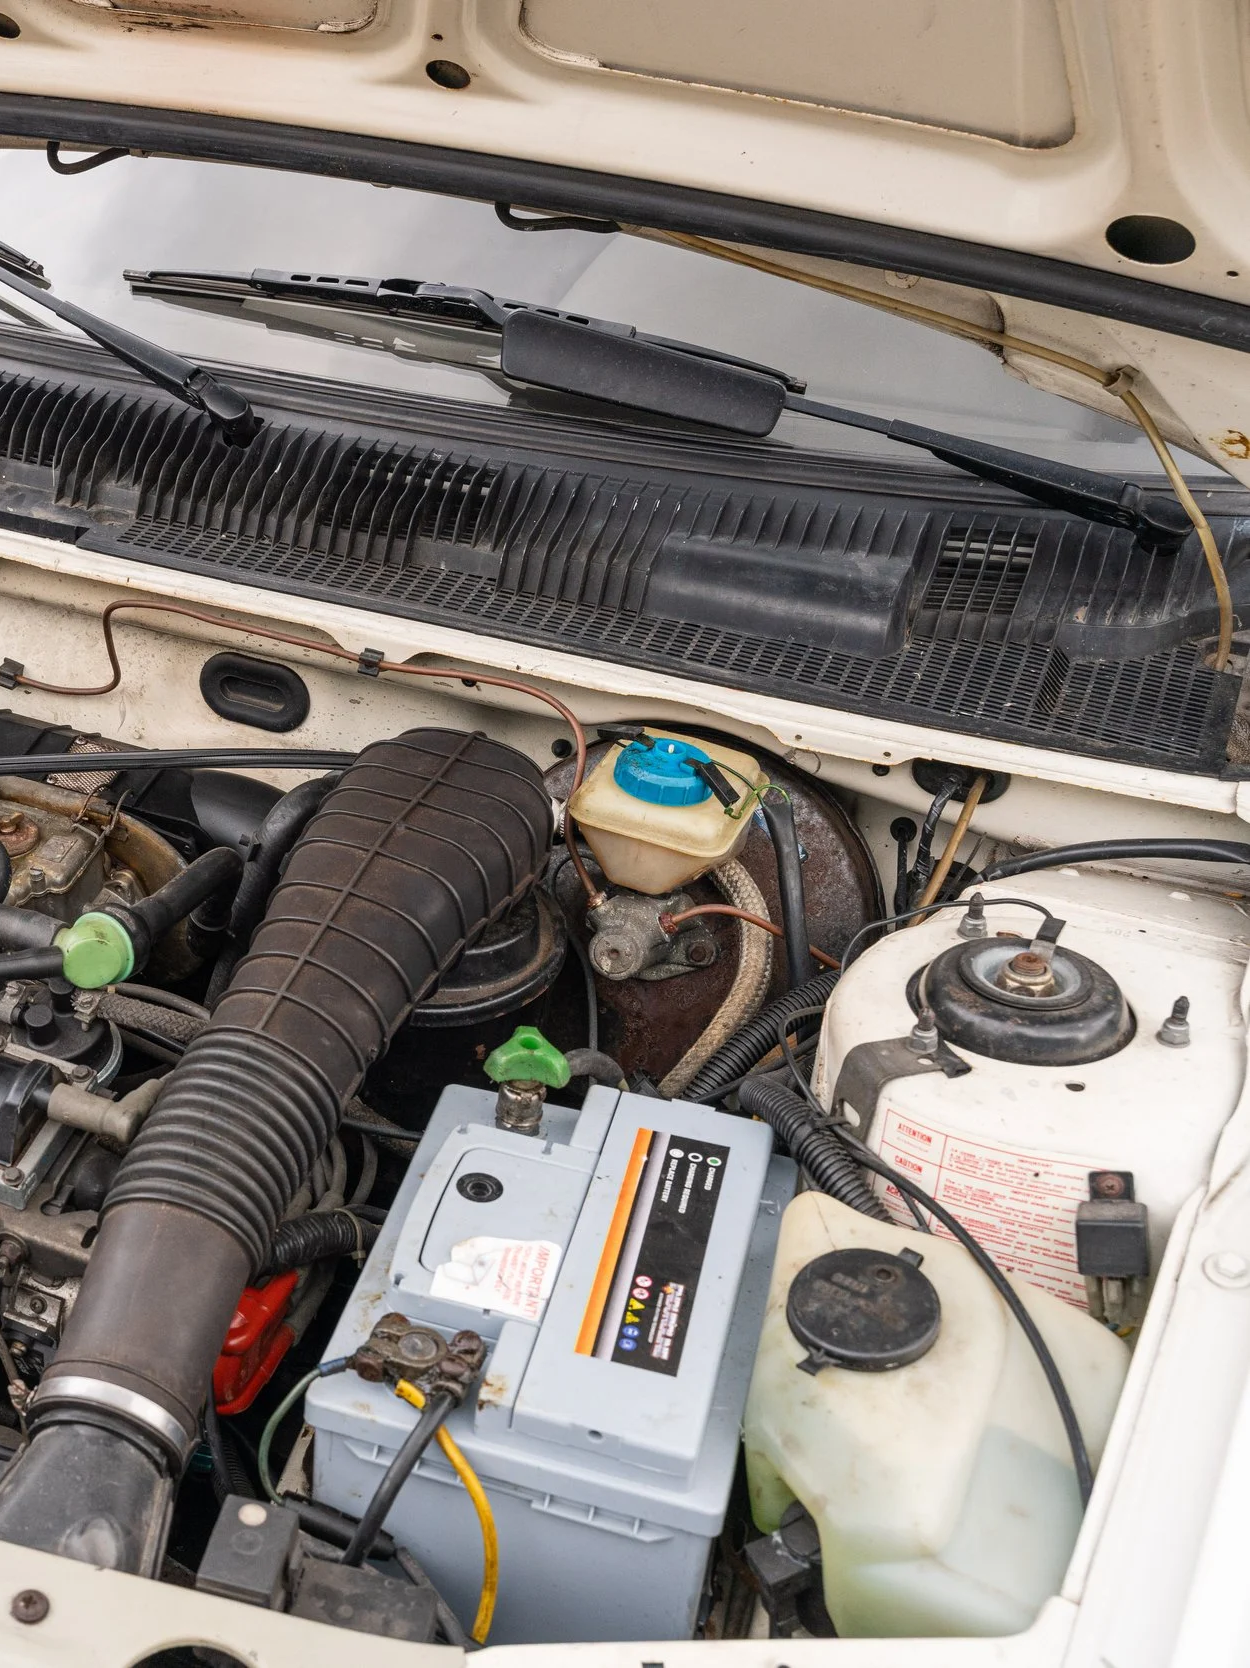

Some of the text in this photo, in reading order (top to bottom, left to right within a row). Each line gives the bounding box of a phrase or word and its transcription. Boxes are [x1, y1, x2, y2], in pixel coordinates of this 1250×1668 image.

[897, 1123, 933, 1144] ATTENTION
[894, 1155, 923, 1173] CAUTION
[661, 1158, 679, 1204] REPLACE BATTERY
[677, 1162, 698, 1215] CHARGING REQUIRED
[704, 1167, 717, 1191] CHARGED
